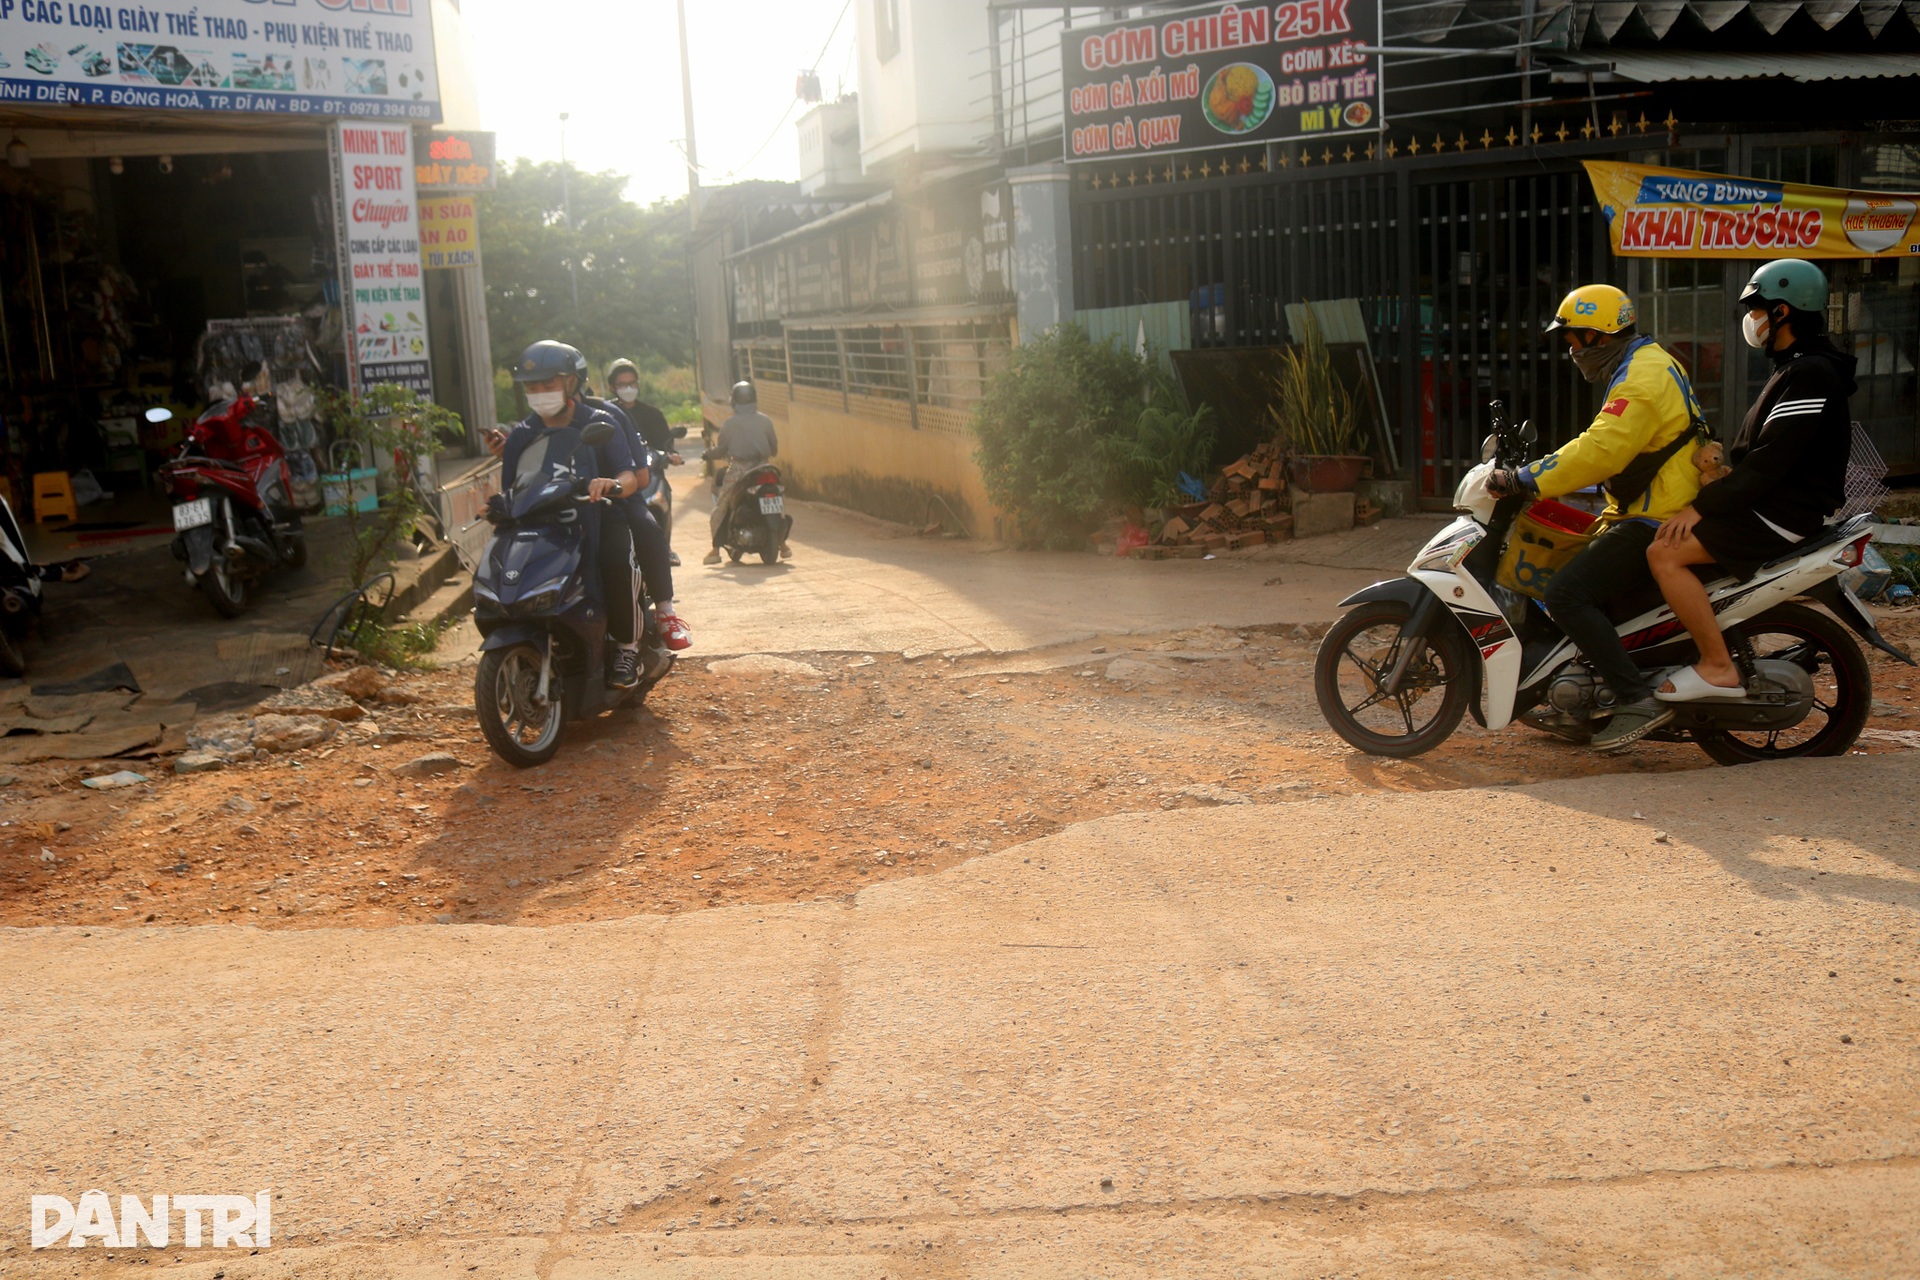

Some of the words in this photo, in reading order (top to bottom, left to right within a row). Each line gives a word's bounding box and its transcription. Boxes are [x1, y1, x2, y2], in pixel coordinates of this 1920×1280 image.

[68, 2, 113, 34] LOẠI
[118, 5, 160, 34] GIÀY
[165, 6, 200, 37] THỂ
[203, 15, 248, 40] THAO
[263, 21, 298, 49] PHỤ
[302, 21, 340, 51] KIỆN
[343, 21, 373, 50] THỂ
[375, 31, 413, 53] THAO
[1081, 26, 1157, 71] CƠM
[1161, 5, 1271, 57] CHIÊN
[1274, 0, 1355, 43] 25K
[1281, 47, 1326, 74] CƠM
[1070, 83, 1108, 115] CƠM
[1110, 74, 1135, 109] GÀ
[1136, 66, 1167, 105] XỐI
[1169, 63, 1200, 100] MỠ
[1278, 79, 1305, 107] BÒ
[1308, 75, 1340, 103] BÍT
[1341, 68, 1377, 99] TẾT
[91, 89, 105, 102] P.
[110, 87, 161, 106] ĐÔNG
[209, 95, 231, 110] TP.
[235, 95, 250, 110] DĨ
[254, 98, 276, 111] AN
[289, 100, 311, 112] BD
[323, 101, 346, 114] ĐT:
[350, 102, 380, 115] 0978
[383, 104, 405, 116] 394
[409, 105, 430, 117] 038
[1301, 104, 1325, 132] MÌ
[1329, 102, 1342, 129] Ý
[342, 128, 379, 155] MINH
[381, 128, 407, 156] THƯ
[1072, 123, 1109, 155] CƠM
[1112, 116, 1136, 150] GÀ
[1139, 114, 1181, 149] QUAY
[353, 165, 402, 190] SPORT
[1656, 181, 1709, 202] TƯNG
[352, 198, 409, 229] Chuyên
[419, 205, 434, 220] N
[1845, 210, 1870, 231] HUẾ
[446, 225, 468, 243] ÁO
[1620, 207, 1697, 250] KHAI
[1699, 203, 1824, 249] TRƯƠNG
[353, 260, 375, 279] GIÀY
[377, 257, 394, 279] THỂ
[396, 262, 419, 278] THAO
[447, 247, 475, 265] XÁCH
[1575, 298, 1597, 315] be
[1619, 726, 1648, 744] crocs
